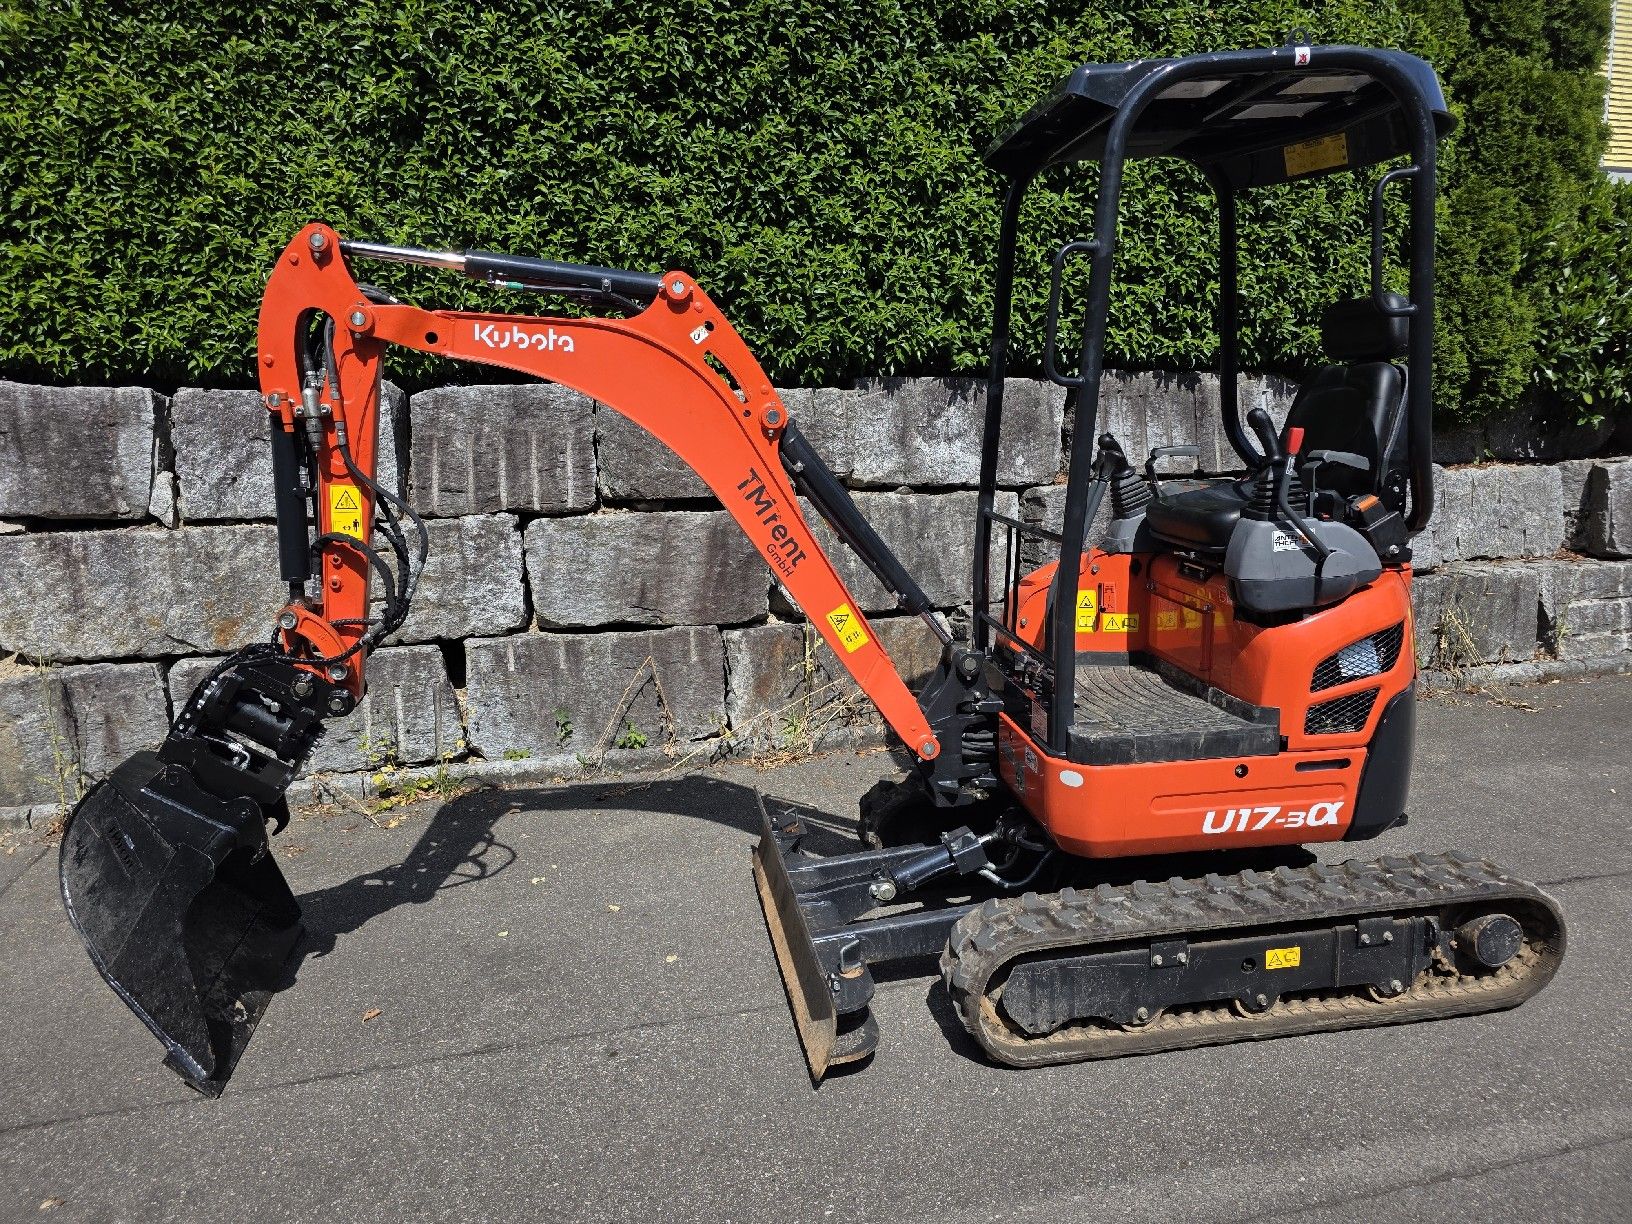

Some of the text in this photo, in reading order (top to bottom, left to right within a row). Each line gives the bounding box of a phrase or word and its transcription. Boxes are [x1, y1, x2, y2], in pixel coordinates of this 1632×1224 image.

[474, 323, 574, 352] Kubota
[737, 467, 806, 567] TMrent
[767, 543, 794, 578] GmbH
